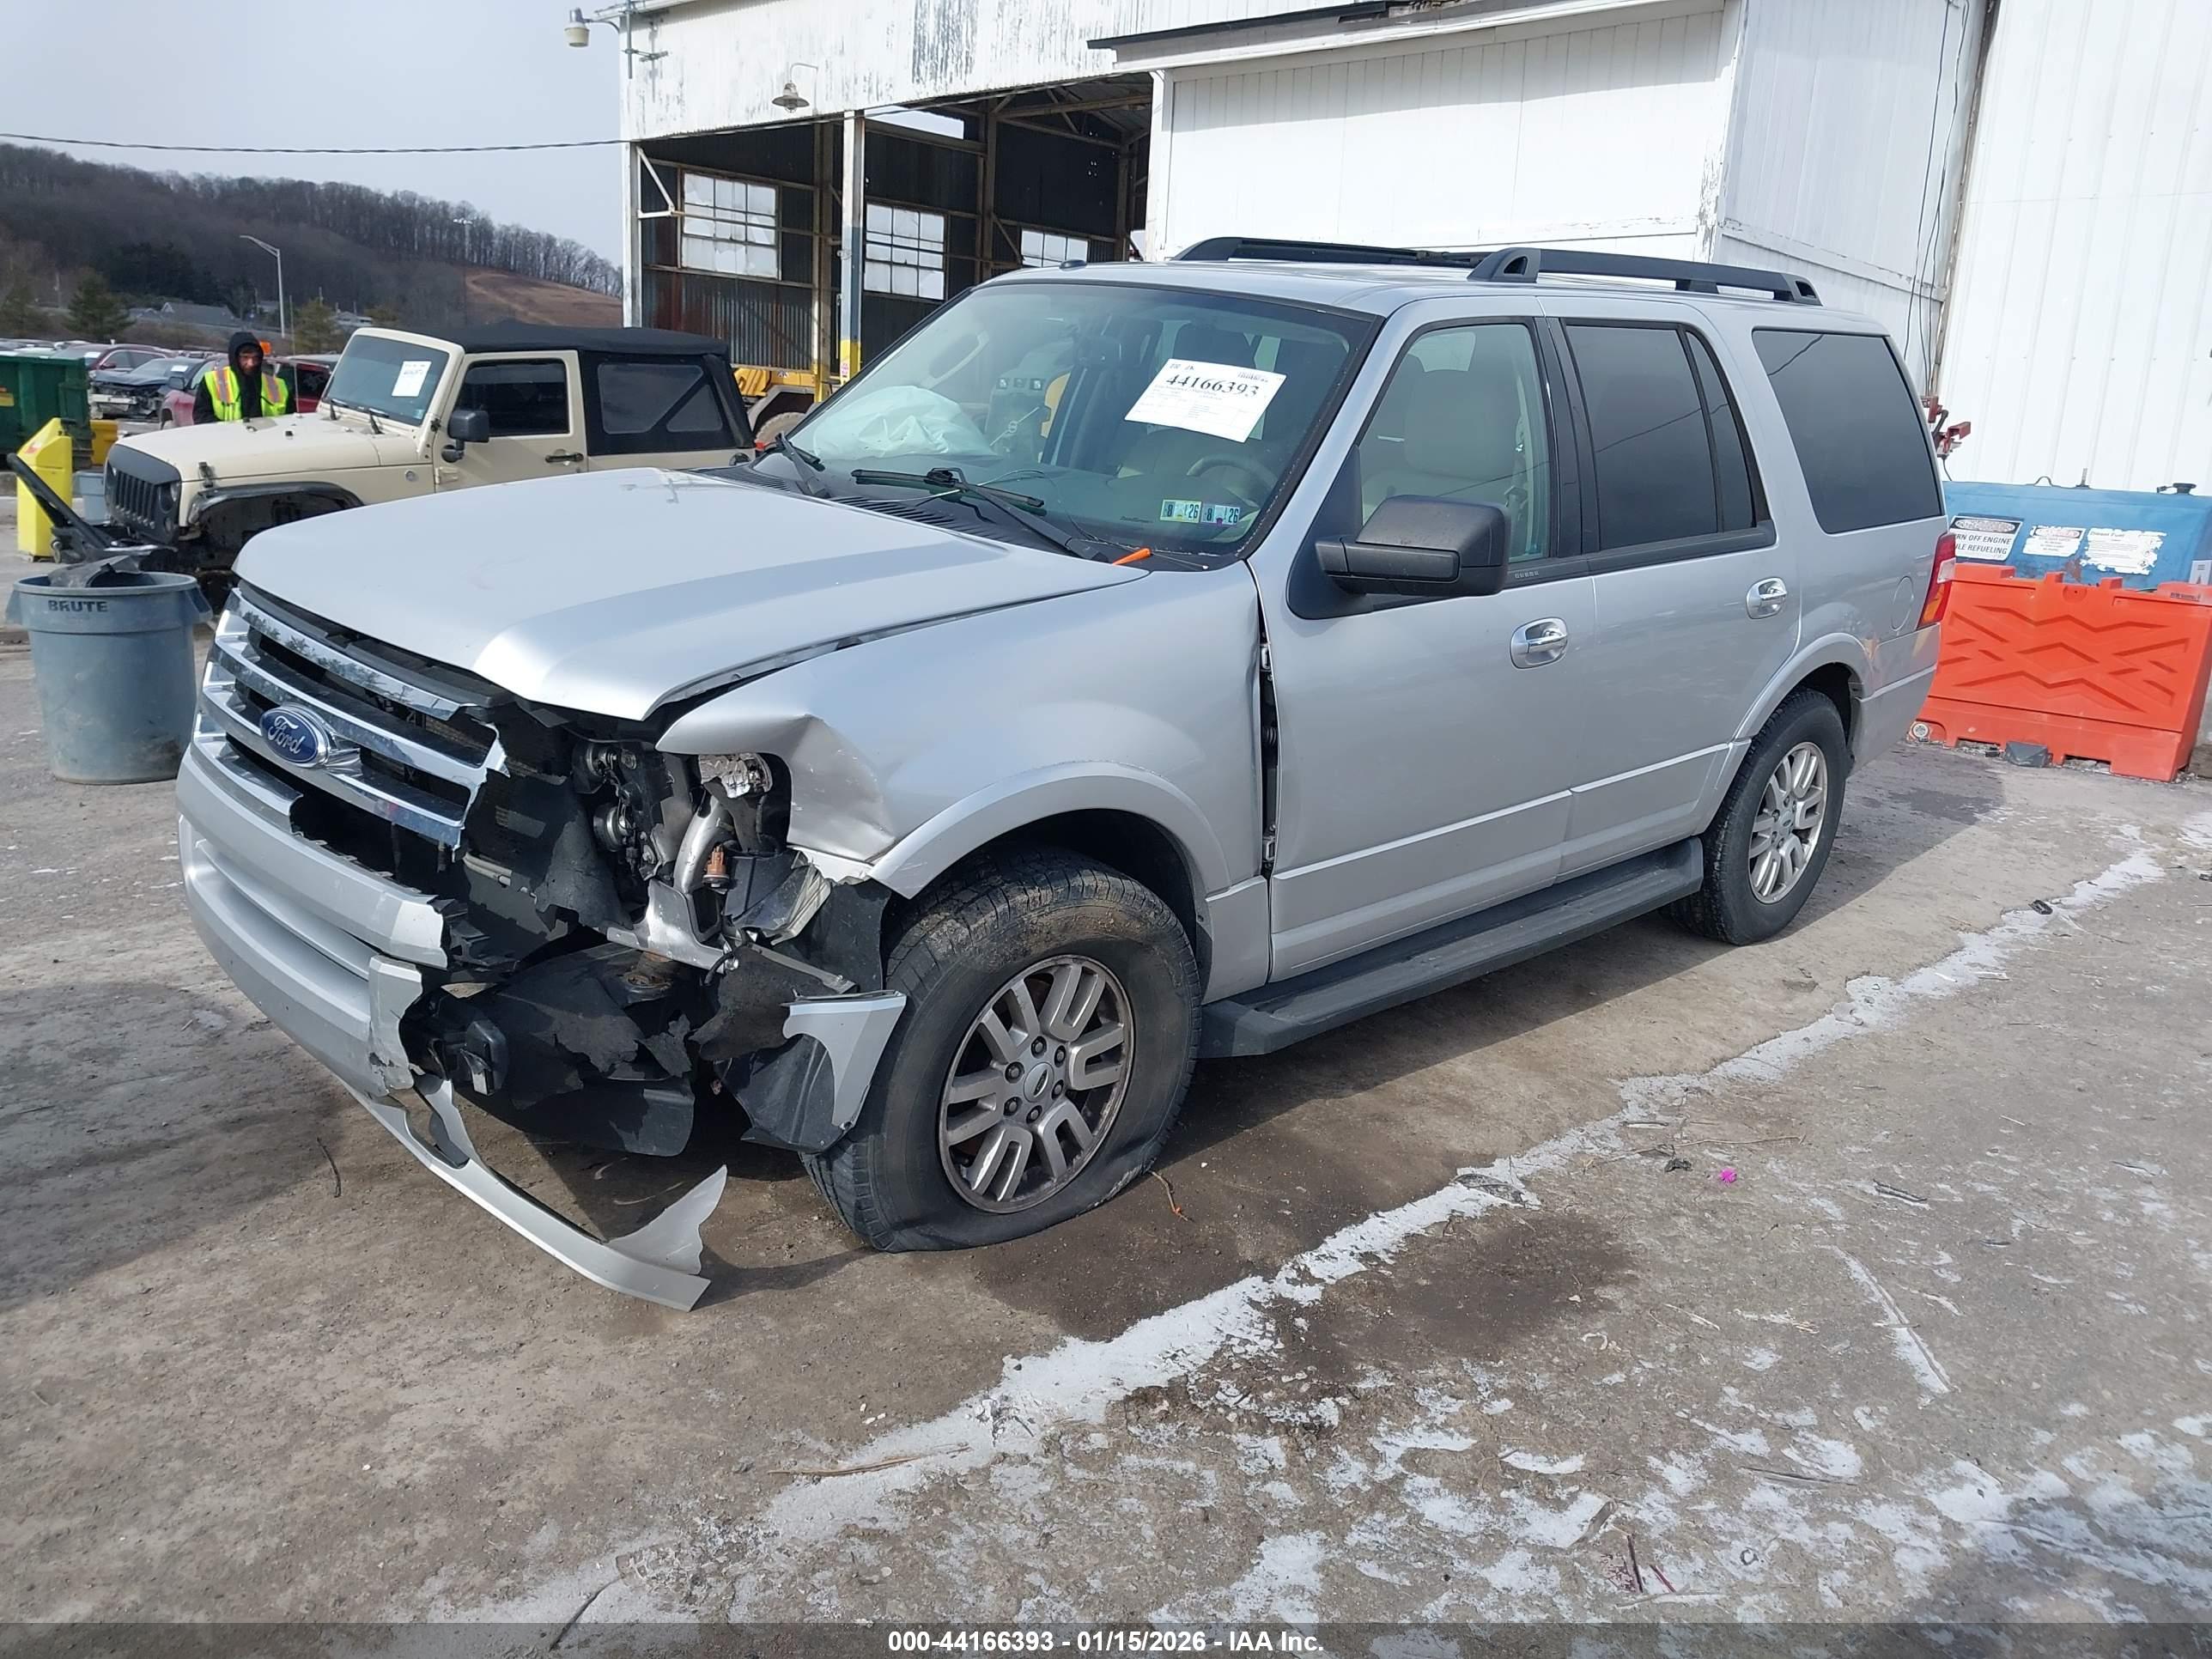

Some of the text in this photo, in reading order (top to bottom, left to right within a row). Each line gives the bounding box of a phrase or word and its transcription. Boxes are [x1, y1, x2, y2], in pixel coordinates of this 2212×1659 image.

[1166, 374, 1260, 395] 44166393
[1983, 536, 2012, 544] ENGINE
[1967, 544, 2008, 555] REFUELING
[47, 599, 108, 612] BRUTE
[268, 715, 306, 754] Ford
